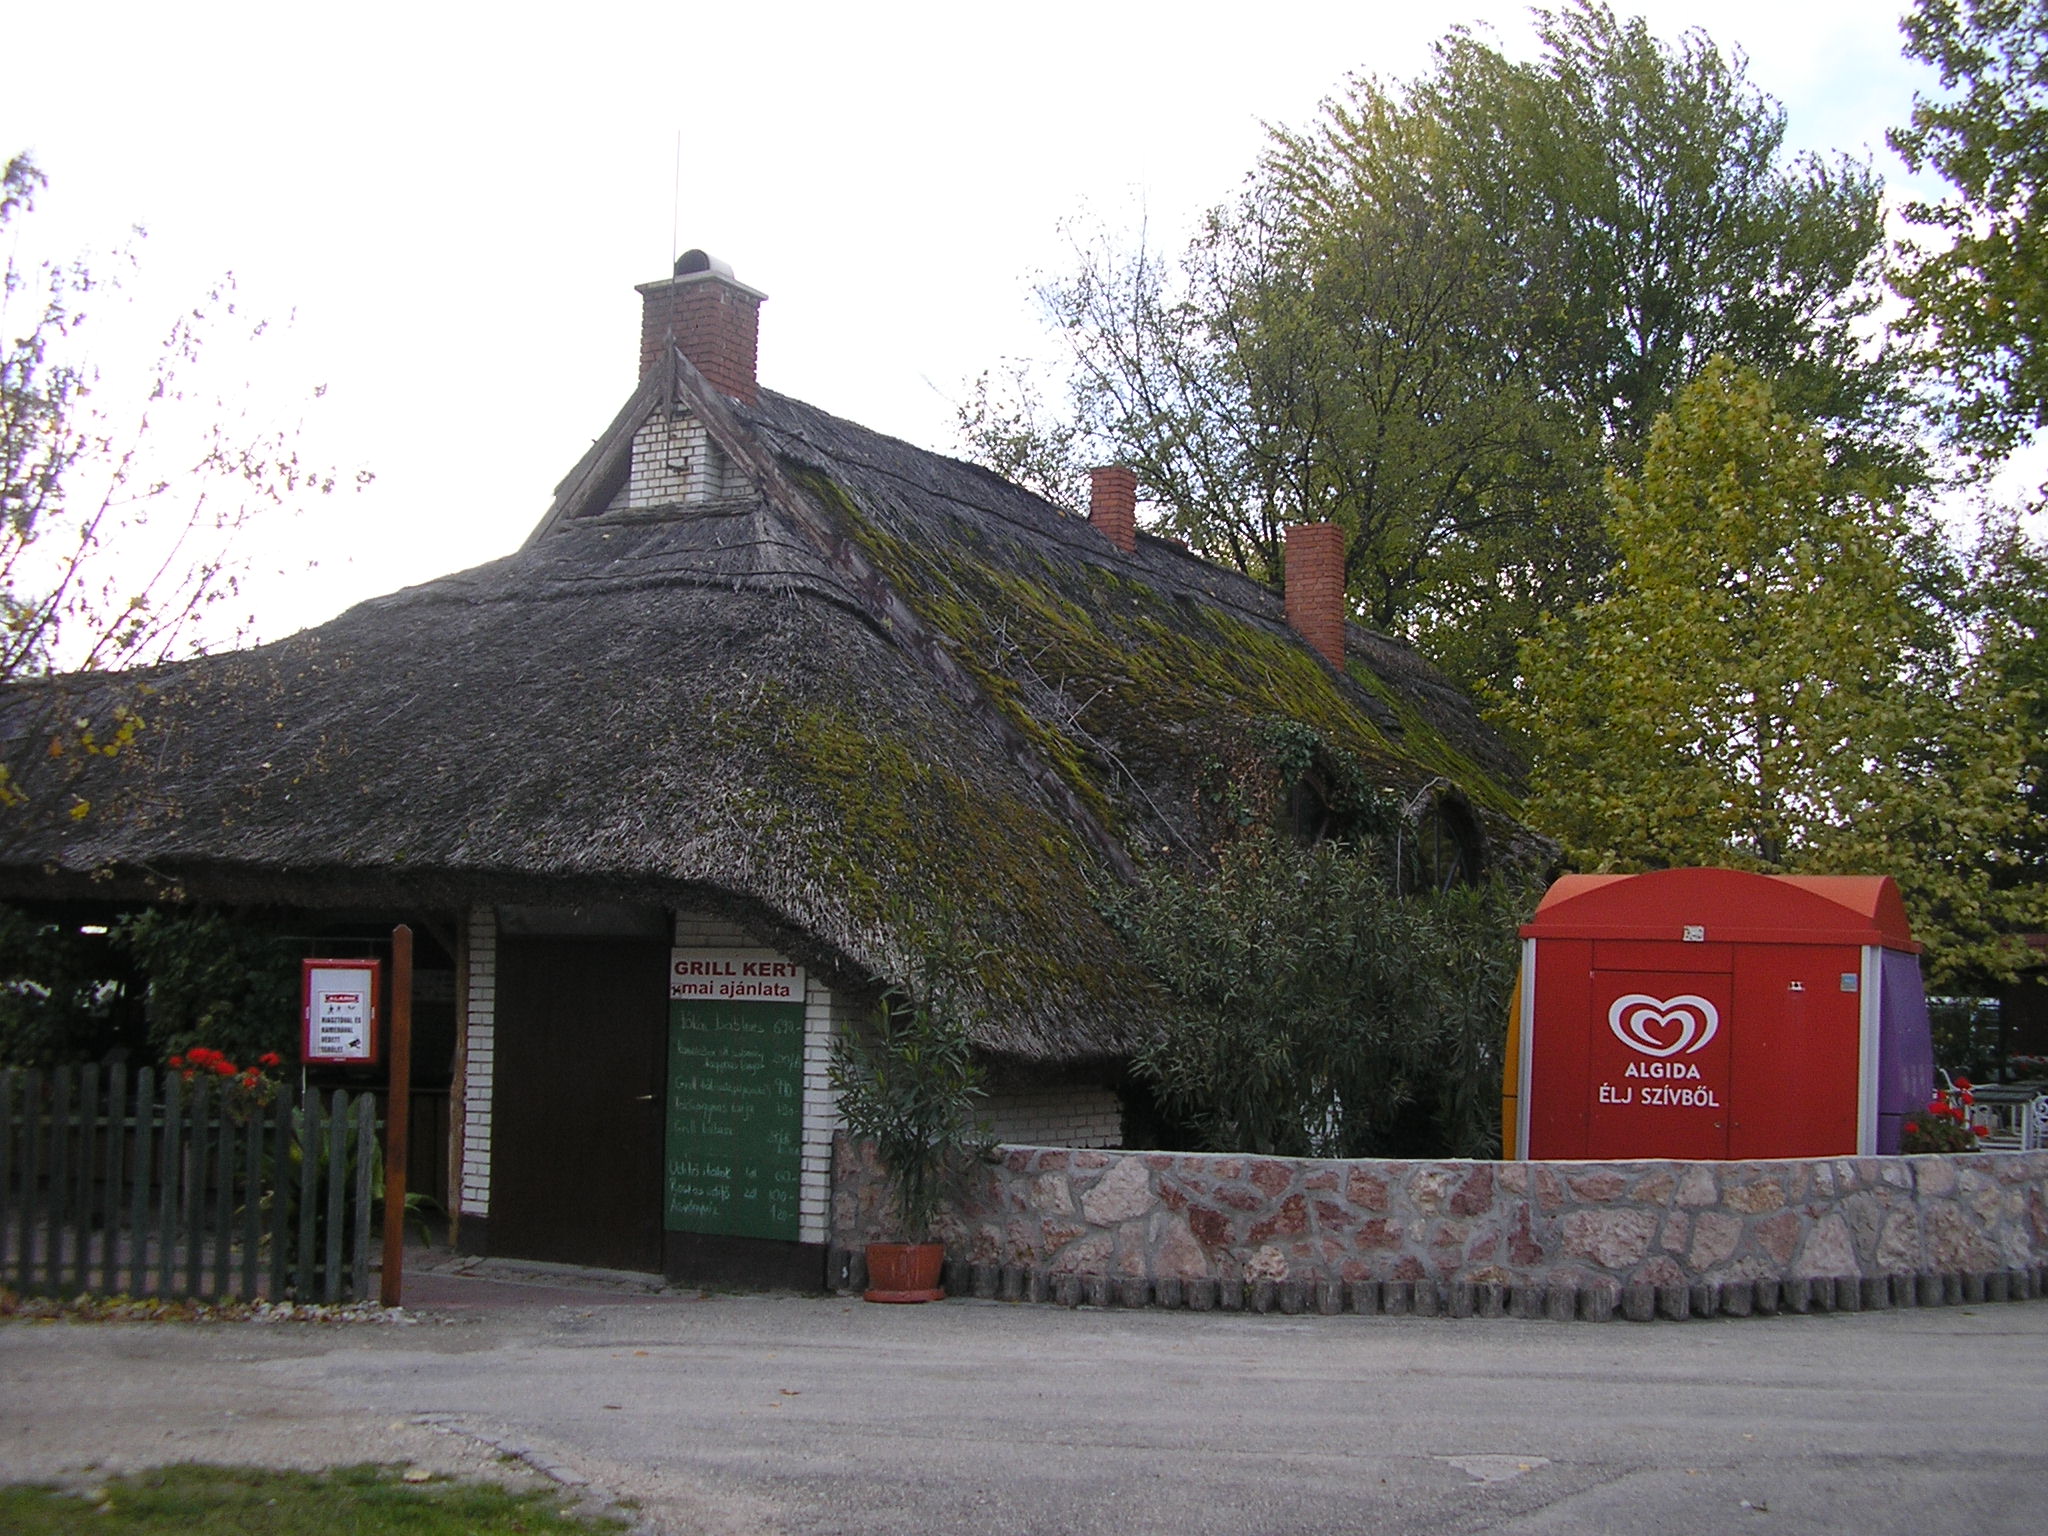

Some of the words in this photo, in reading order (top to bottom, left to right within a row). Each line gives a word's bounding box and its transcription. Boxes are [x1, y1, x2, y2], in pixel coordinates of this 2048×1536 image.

[674, 961, 736, 976] GRILL
[682, 980, 714, 995] mai
[719, 981, 790, 998] ajánlata
[1624, 1062, 1701, 1079] ALGIDA
[1599, 1082, 1633, 1104] ÉLJ
[1641, 1084, 1720, 1107] SZÍVBŐL
